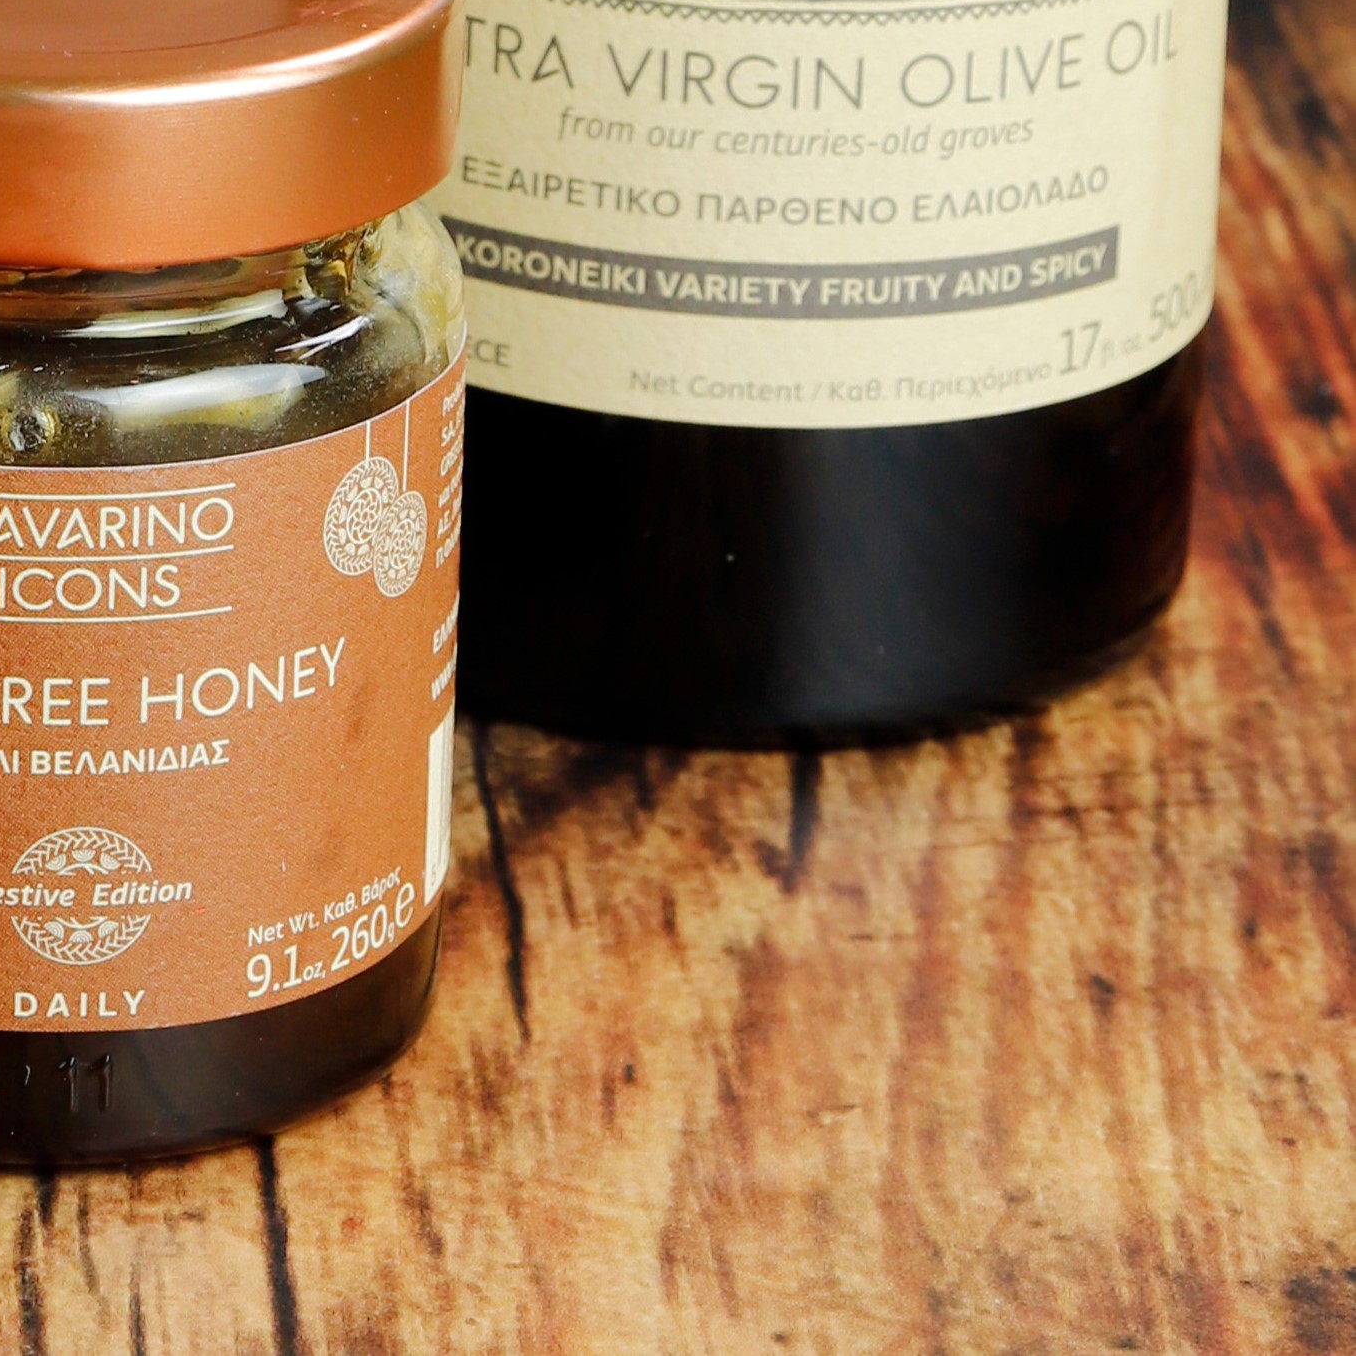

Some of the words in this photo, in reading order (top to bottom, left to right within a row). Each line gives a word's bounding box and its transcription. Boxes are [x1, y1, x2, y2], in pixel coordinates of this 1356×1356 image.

[465, 15, 574, 88] TRA
[607, 43, 864, 109] VIRGIN
[901, 33, 1085, 107] OLIVE
[1106, 9, 1178, 75] OIL
[557, 107, 633, 143] from
[648, 124, 704, 151] our
[715, 123, 931, 157] centuries-old
[939, 118, 1035, 161] groves
[462, 156, 681, 218] ΕΞΑΙΡΕΤΙΚΟ
[697, 193, 897, 225] ΠΑΡΘΕΝΟ
[912, 164, 1108, 223] ΕΛΑΙΟΛΑΔΟ
[455, 233, 646, 295] KORONEIKI
[656, 270, 811, 306] VARIETY
[820, 272, 945, 306] FRUITY
[952, 263, 1022, 299] AND
[1029, 242, 1108, 286] SPICY
[630, 371, 678, 396] Net
[689, 374, 802, 402] Content
[1059, 320, 1102, 374] 17
[0, 564, 180, 612] ICONS
[140, 637, 344, 724] HONEY
[31, 739, 230, 775] ΒΕΛΑΝΙΔΙΑΣ
[92, 880, 192, 906] Edition
[248, 922, 285, 947] Net
[289, 912, 320, 934] Wt.
[14, 990, 145, 1018] DAILY
